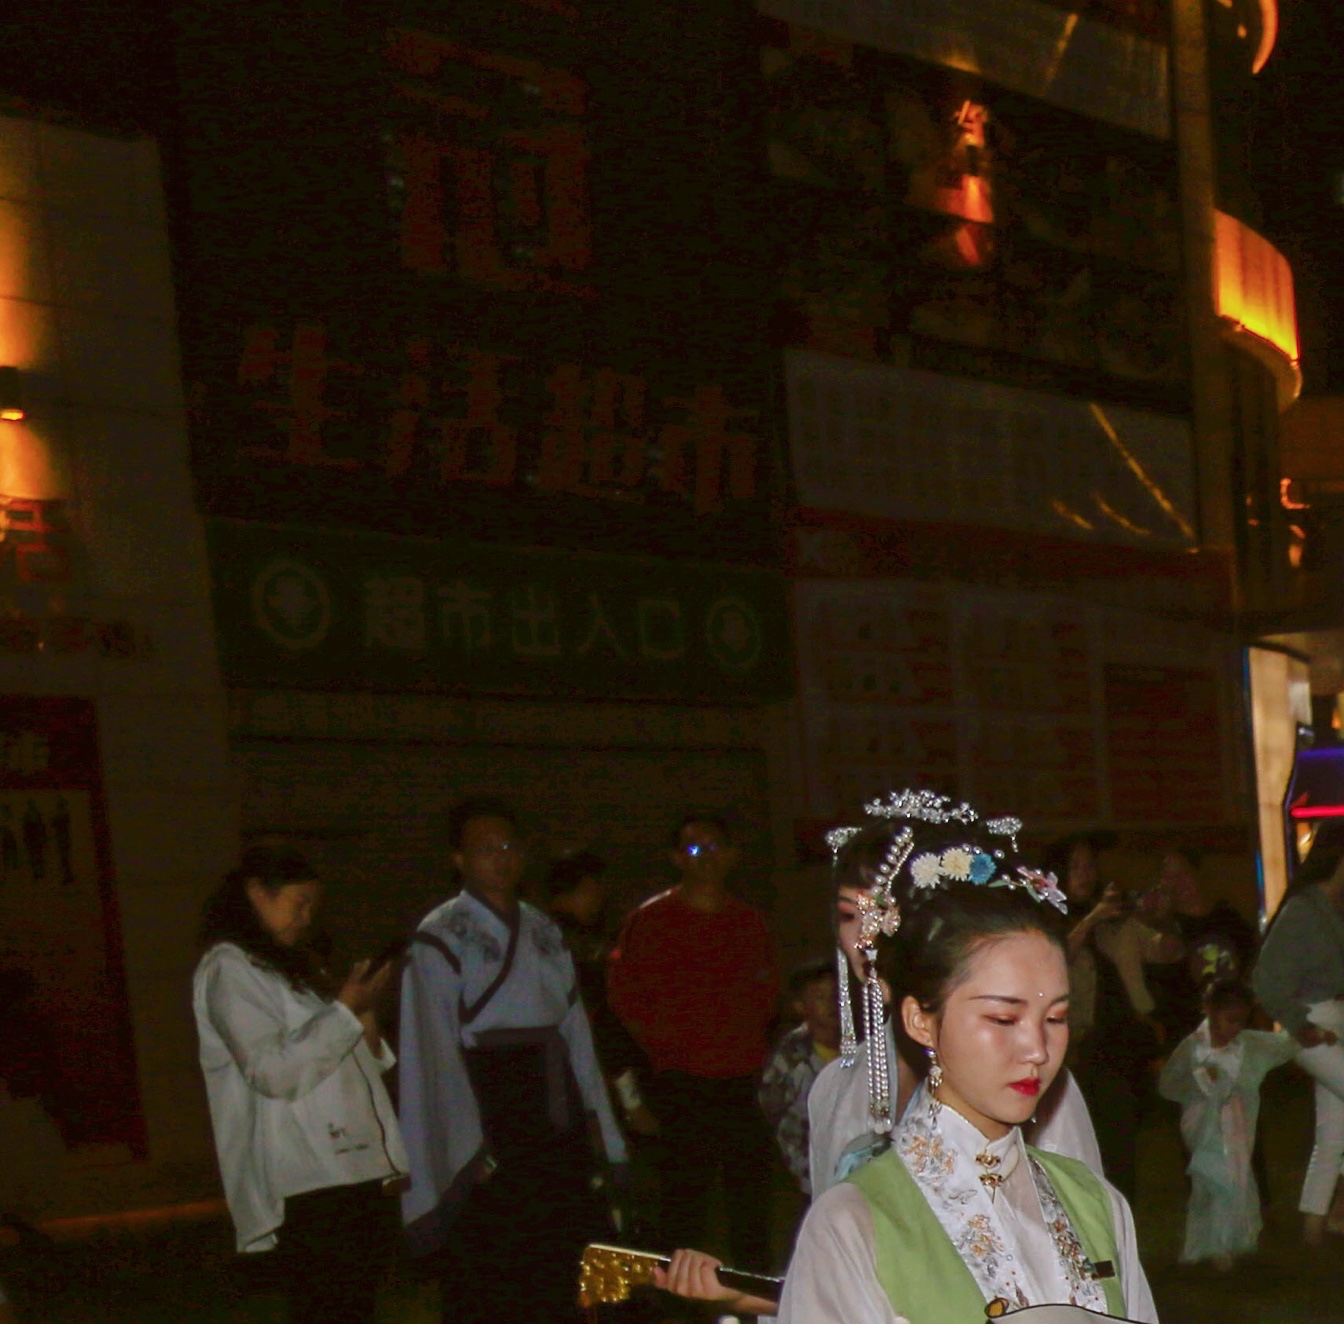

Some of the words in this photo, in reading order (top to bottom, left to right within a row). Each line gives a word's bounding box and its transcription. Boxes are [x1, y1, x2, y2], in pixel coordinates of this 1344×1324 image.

[363, 571, 688, 661] 超市出入口
